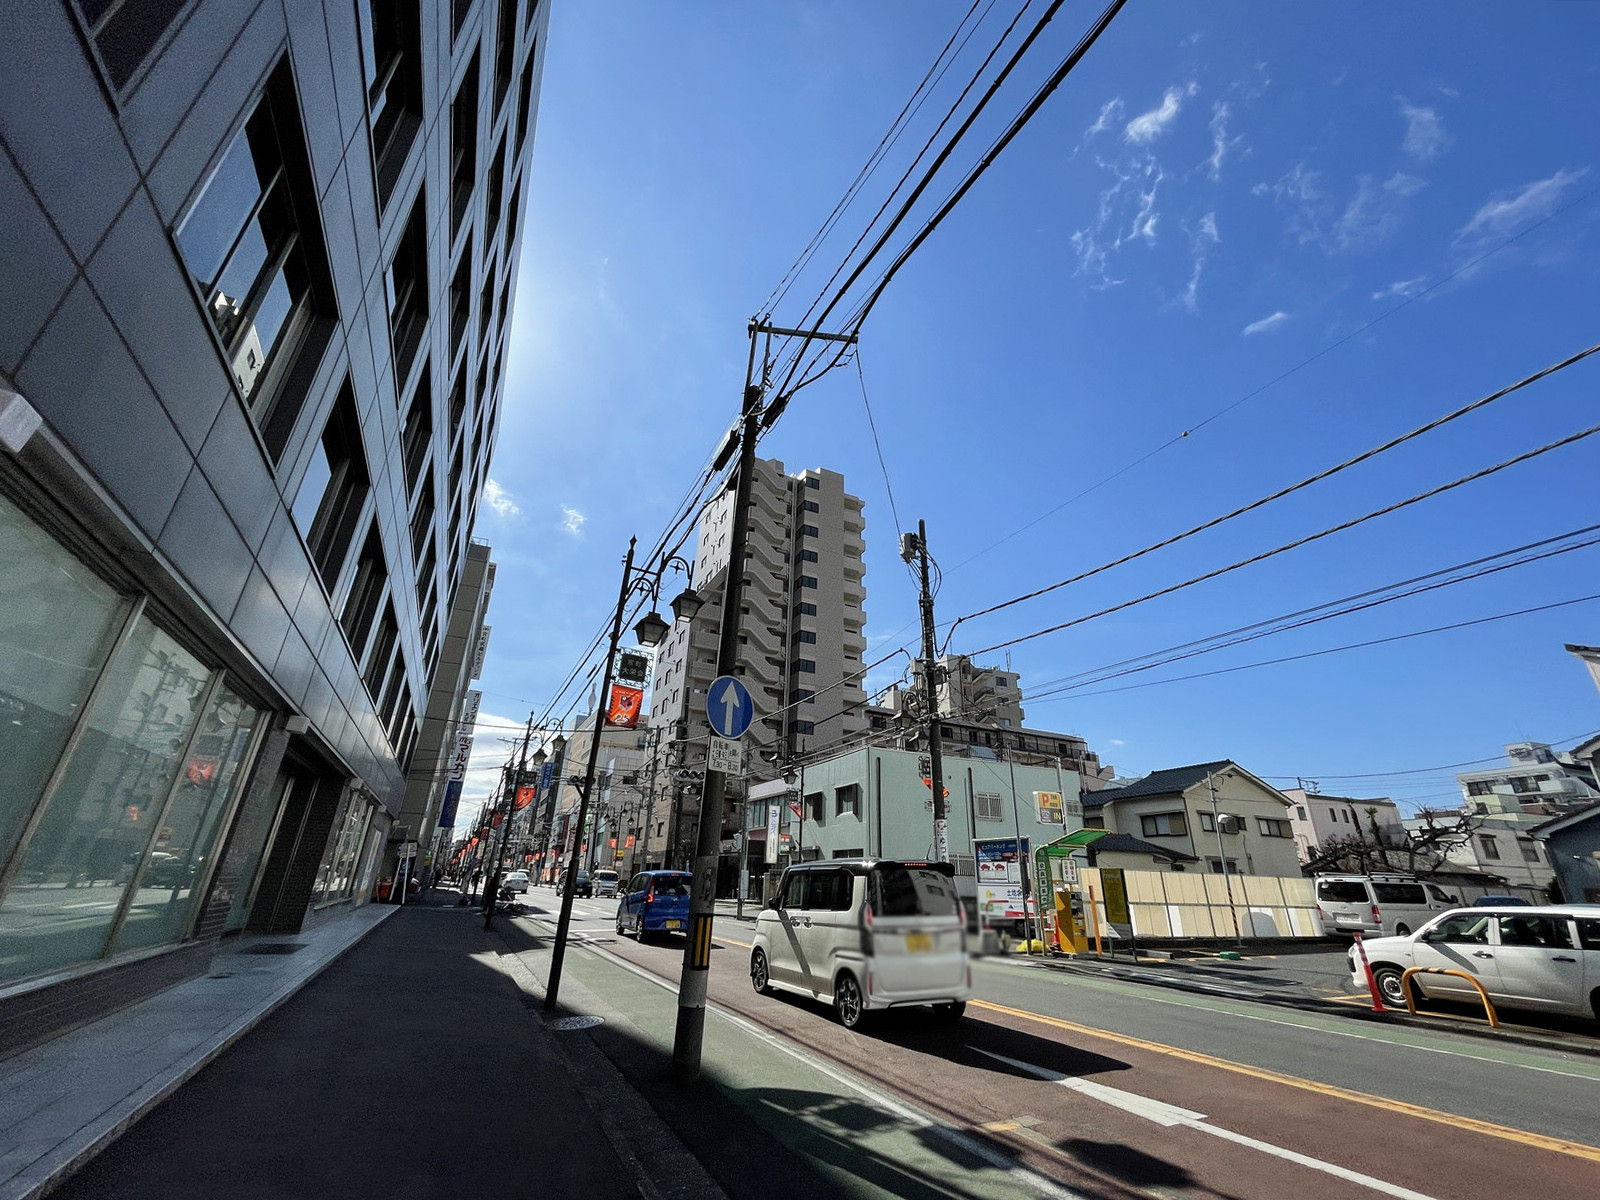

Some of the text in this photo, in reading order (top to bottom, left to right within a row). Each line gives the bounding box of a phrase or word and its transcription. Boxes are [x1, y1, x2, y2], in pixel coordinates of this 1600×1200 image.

[712, 740, 728, 750] 自転車
[1041, 794, 1049, 807] P
[1053, 812, 1062, 820] IN
